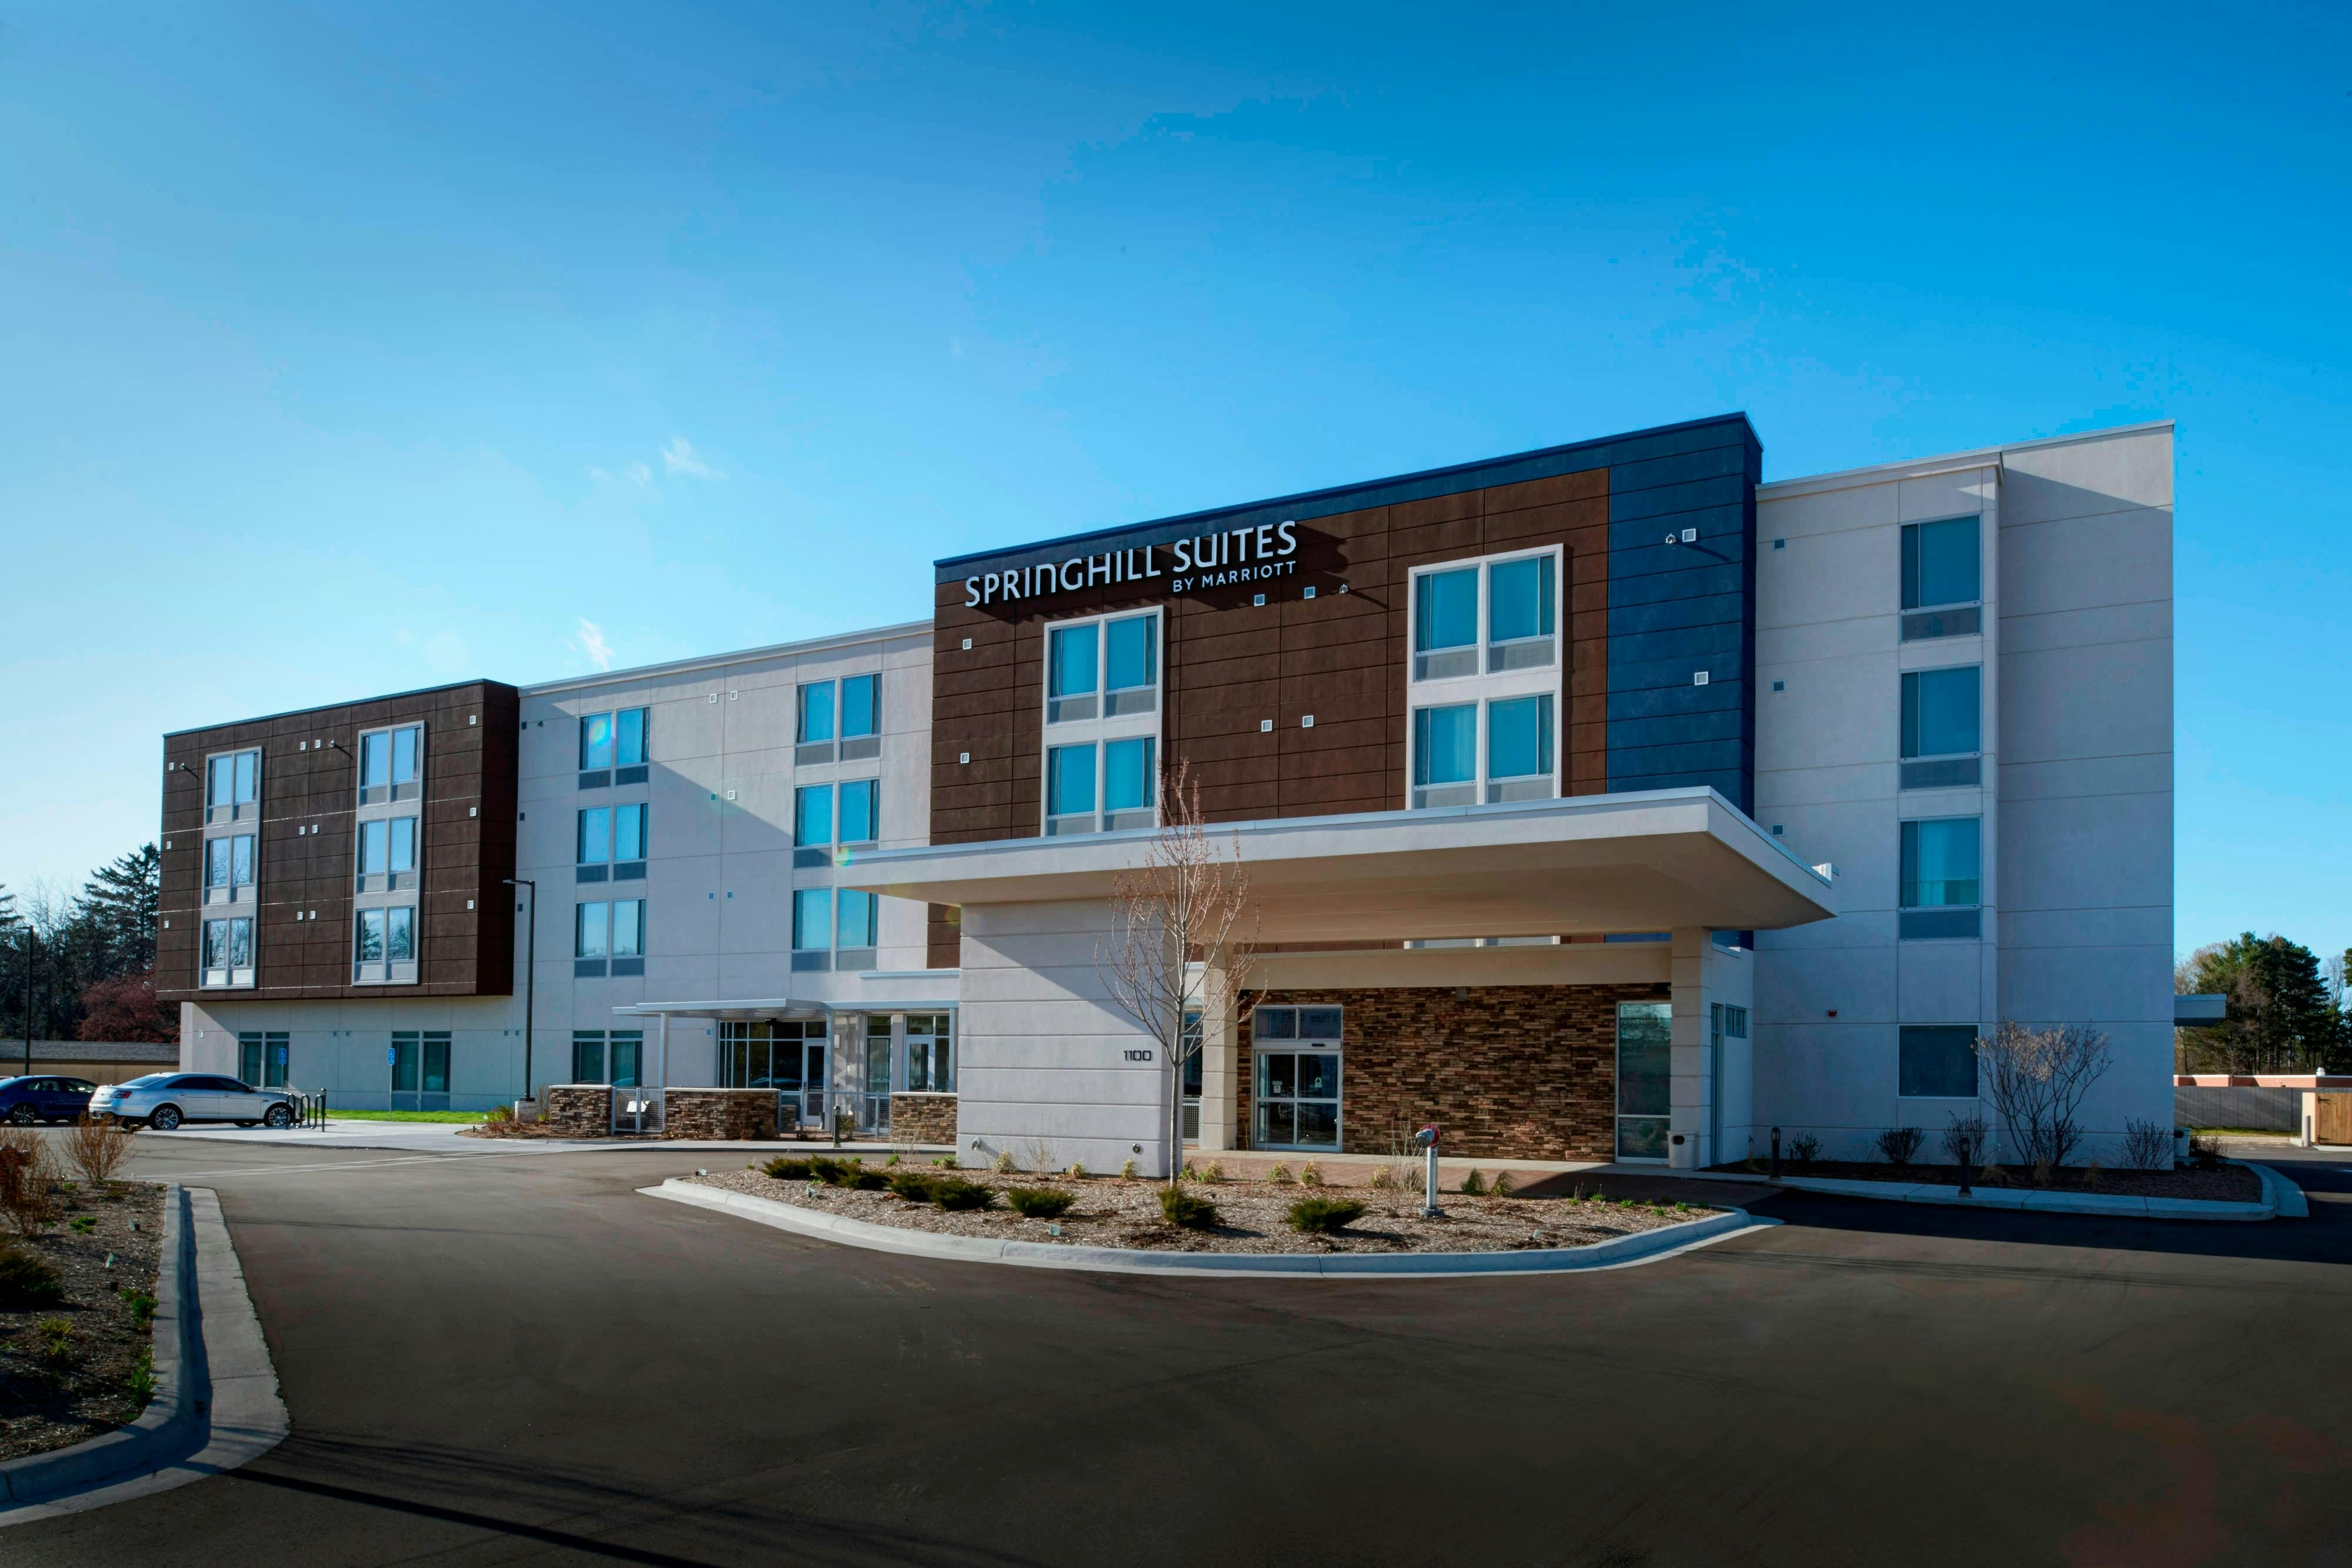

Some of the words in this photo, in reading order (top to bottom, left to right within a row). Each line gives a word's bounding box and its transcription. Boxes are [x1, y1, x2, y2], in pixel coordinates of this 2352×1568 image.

[964, 545, 1161, 607] SPRINGHILL
[1172, 520, 1297, 573] SUITES
[1172, 577, 1194, 593] BY
[1201, 560, 1296, 588] MARRIOTT
[1124, 1050, 1151, 1061] 1100
